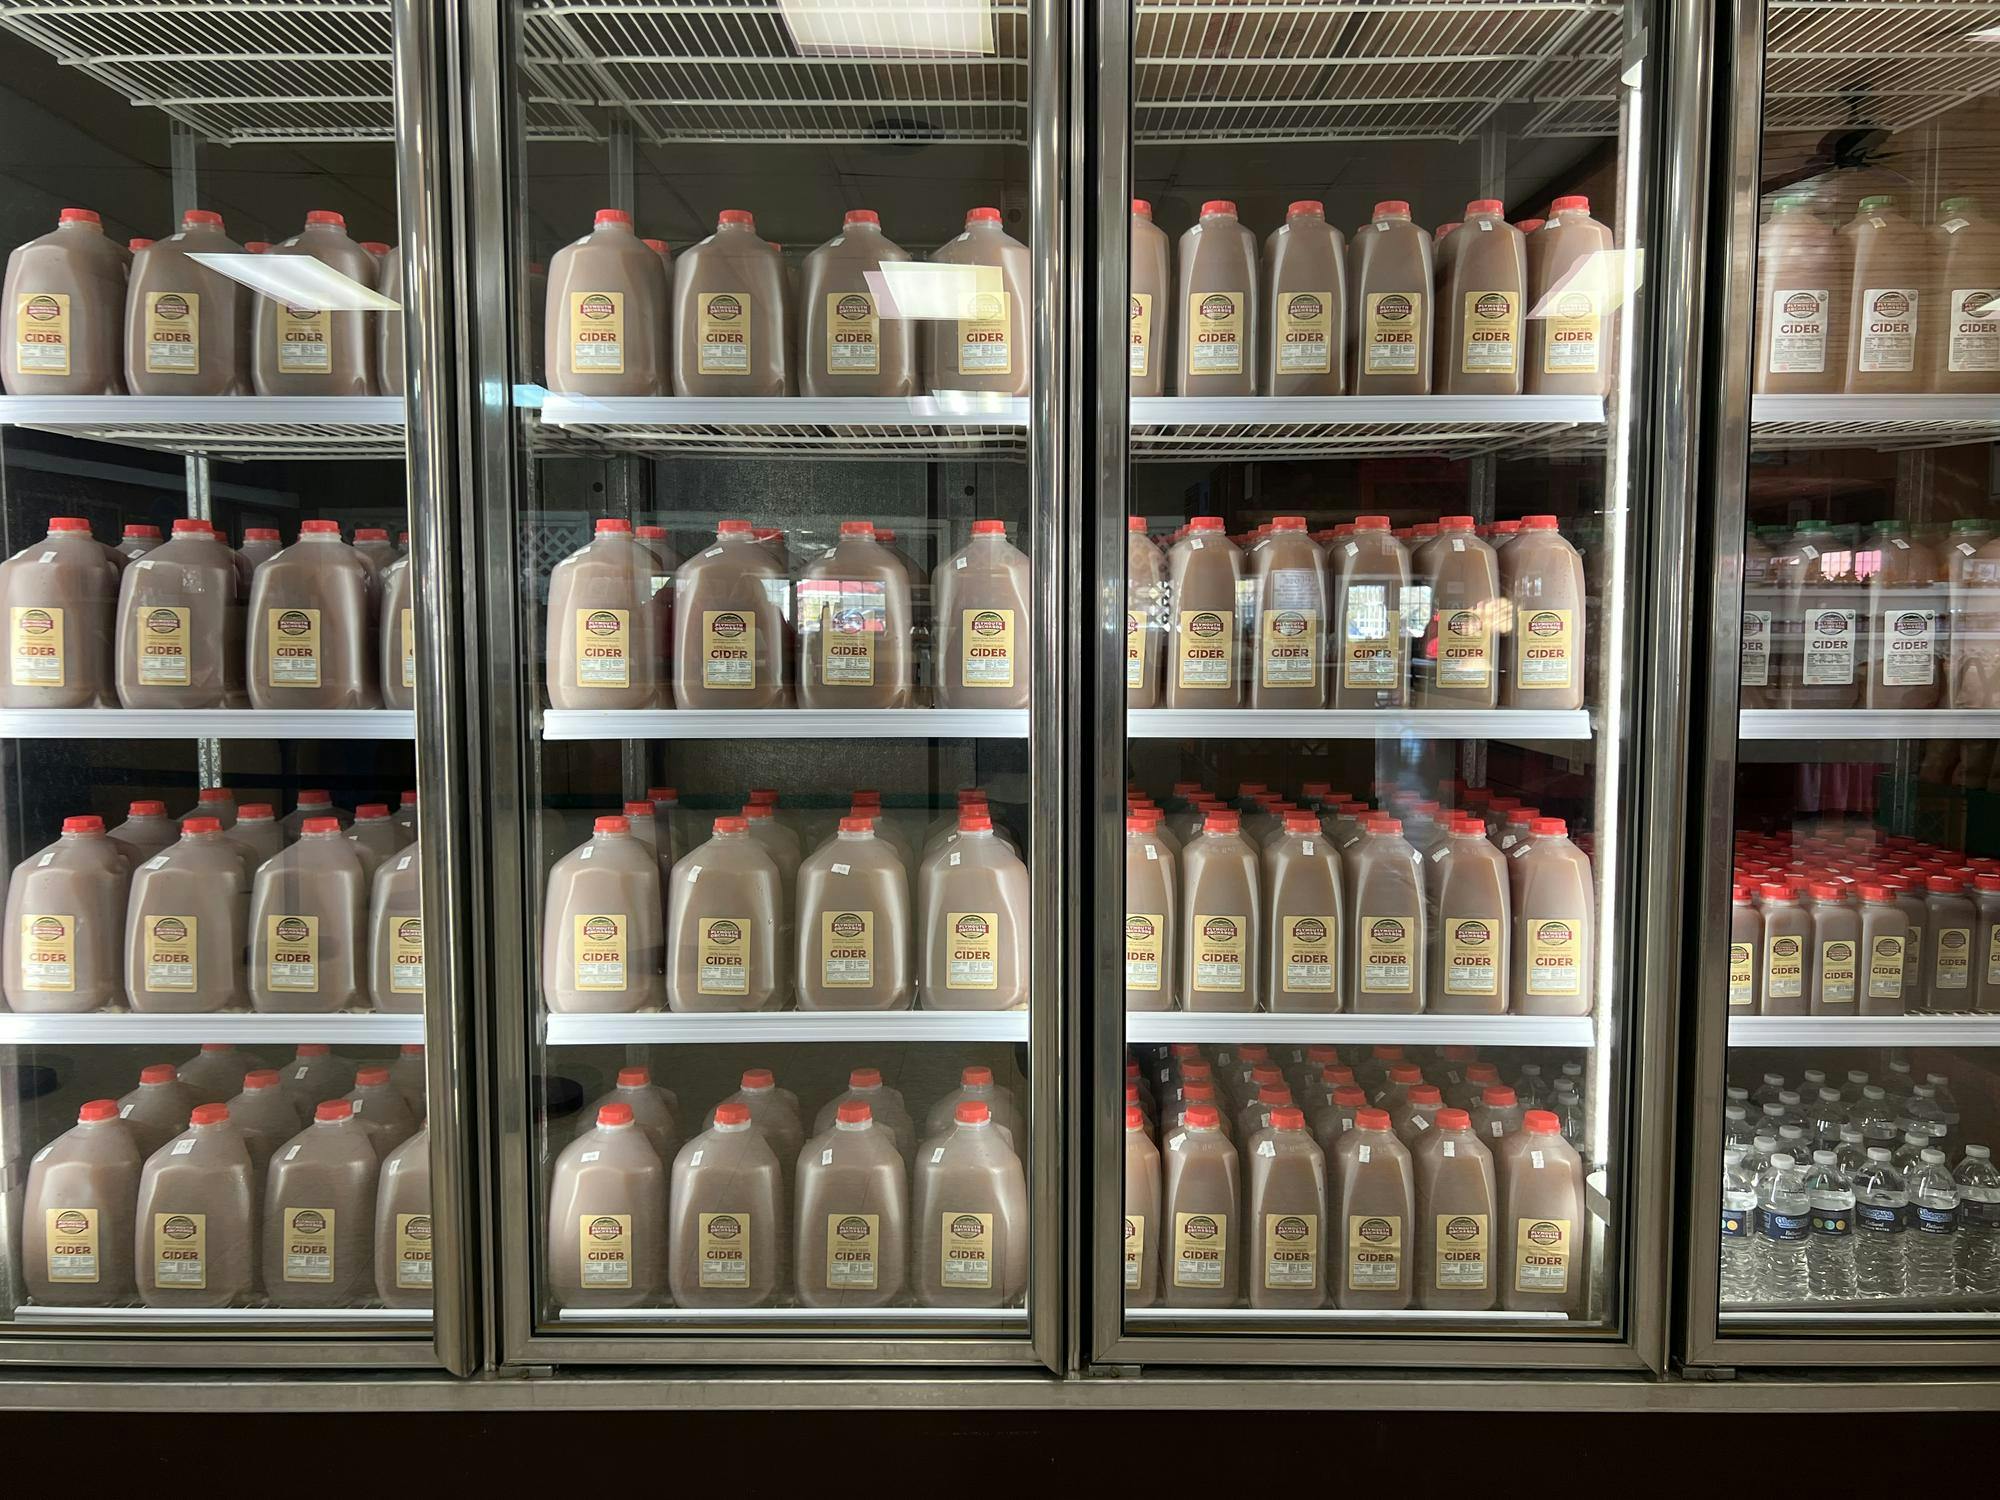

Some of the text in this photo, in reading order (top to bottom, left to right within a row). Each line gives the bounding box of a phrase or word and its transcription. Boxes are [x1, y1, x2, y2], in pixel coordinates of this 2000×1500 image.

[1782, 324, 1819, 334] CIDER
[1871, 323, 1909, 333] CIDER
[1960, 323, 1997, 333] CIDER
[25, 334, 61, 343] CIDER
[154, 333, 190, 342] CIDER
[286, 332, 322, 342] CIDER
[579, 333, 615, 342] CIDER
[706, 334, 742, 343] CIDER
[835, 333, 871, 342] CIDER
[967, 333, 1003, 342] CIDER
[1199, 333, 1235, 342] CIDER
[1286, 333, 1323, 342] CIDER
[1375, 333, 1412, 343] CIDER
[1473, 332, 1510, 341] CIDER
[1555, 332, 1593, 341] CIDER
[1742, 642, 1763, 650] DER
[1813, 640, 1848, 649] CIDER
[1893, 641, 1928, 650] CIDER
[19, 647, 55, 656] CIDER
[145, 646, 181, 655] CIDER
[277, 648, 312, 657] CIDER
[585, 648, 621, 657] CIDER
[711, 650, 747, 659] CIDER
[831, 647, 866, 656] CIDER
[971, 648, 1006, 657] CIDER
[1188, 650, 1224, 659] CIDER
[1272, 648, 1308, 657] CIDER
[1354, 649, 1391, 658] CIDER
[1447, 648, 1483, 657] CIDER
[1528, 649, 1564, 658] CIDER
[30, 953, 66, 962] CIDER
[583, 953, 619, 962] CIDER
[830, 949, 866, 958] CIDER
[955, 951, 990, 960] CIDER
[1127, 952, 1155, 961] IDER
[153, 954, 188, 963] CIDER
[275, 954, 310, 963] CIDER
[398, 955, 424, 964] CIDE
[706, 956, 741, 965] CIDER
[1202, 954, 1238, 963] CIDER
[1292, 954, 1327, 963] CIDER
[1370, 955, 1406, 964] CIDER
[1454, 957, 1490, 966] CIDER
[1536, 957, 1573, 966] CIDER
[1732, 974, 1751, 982] DER
[55, 1246, 90, 1255] CIDER
[291, 1245, 326, 1254] CIDER
[162, 1251, 197, 1260] CIDER
[404, 1251, 431, 1260] CIDE
[589, 1252, 623, 1261] CIDER
[707, 1250, 742, 1259] CIDER
[835, 1252, 870, 1261] CIDER
[950, 1250, 984, 1259] CIDER
[1183, 1251, 1218, 1260] CIDER
[1274, 1252, 1309, 1261] CIDER
[1358, 1253, 1393, 1262] CIDER
[1445, 1252, 1480, 1261] CIDER
[1526, 1257, 1561, 1266] CIDER
